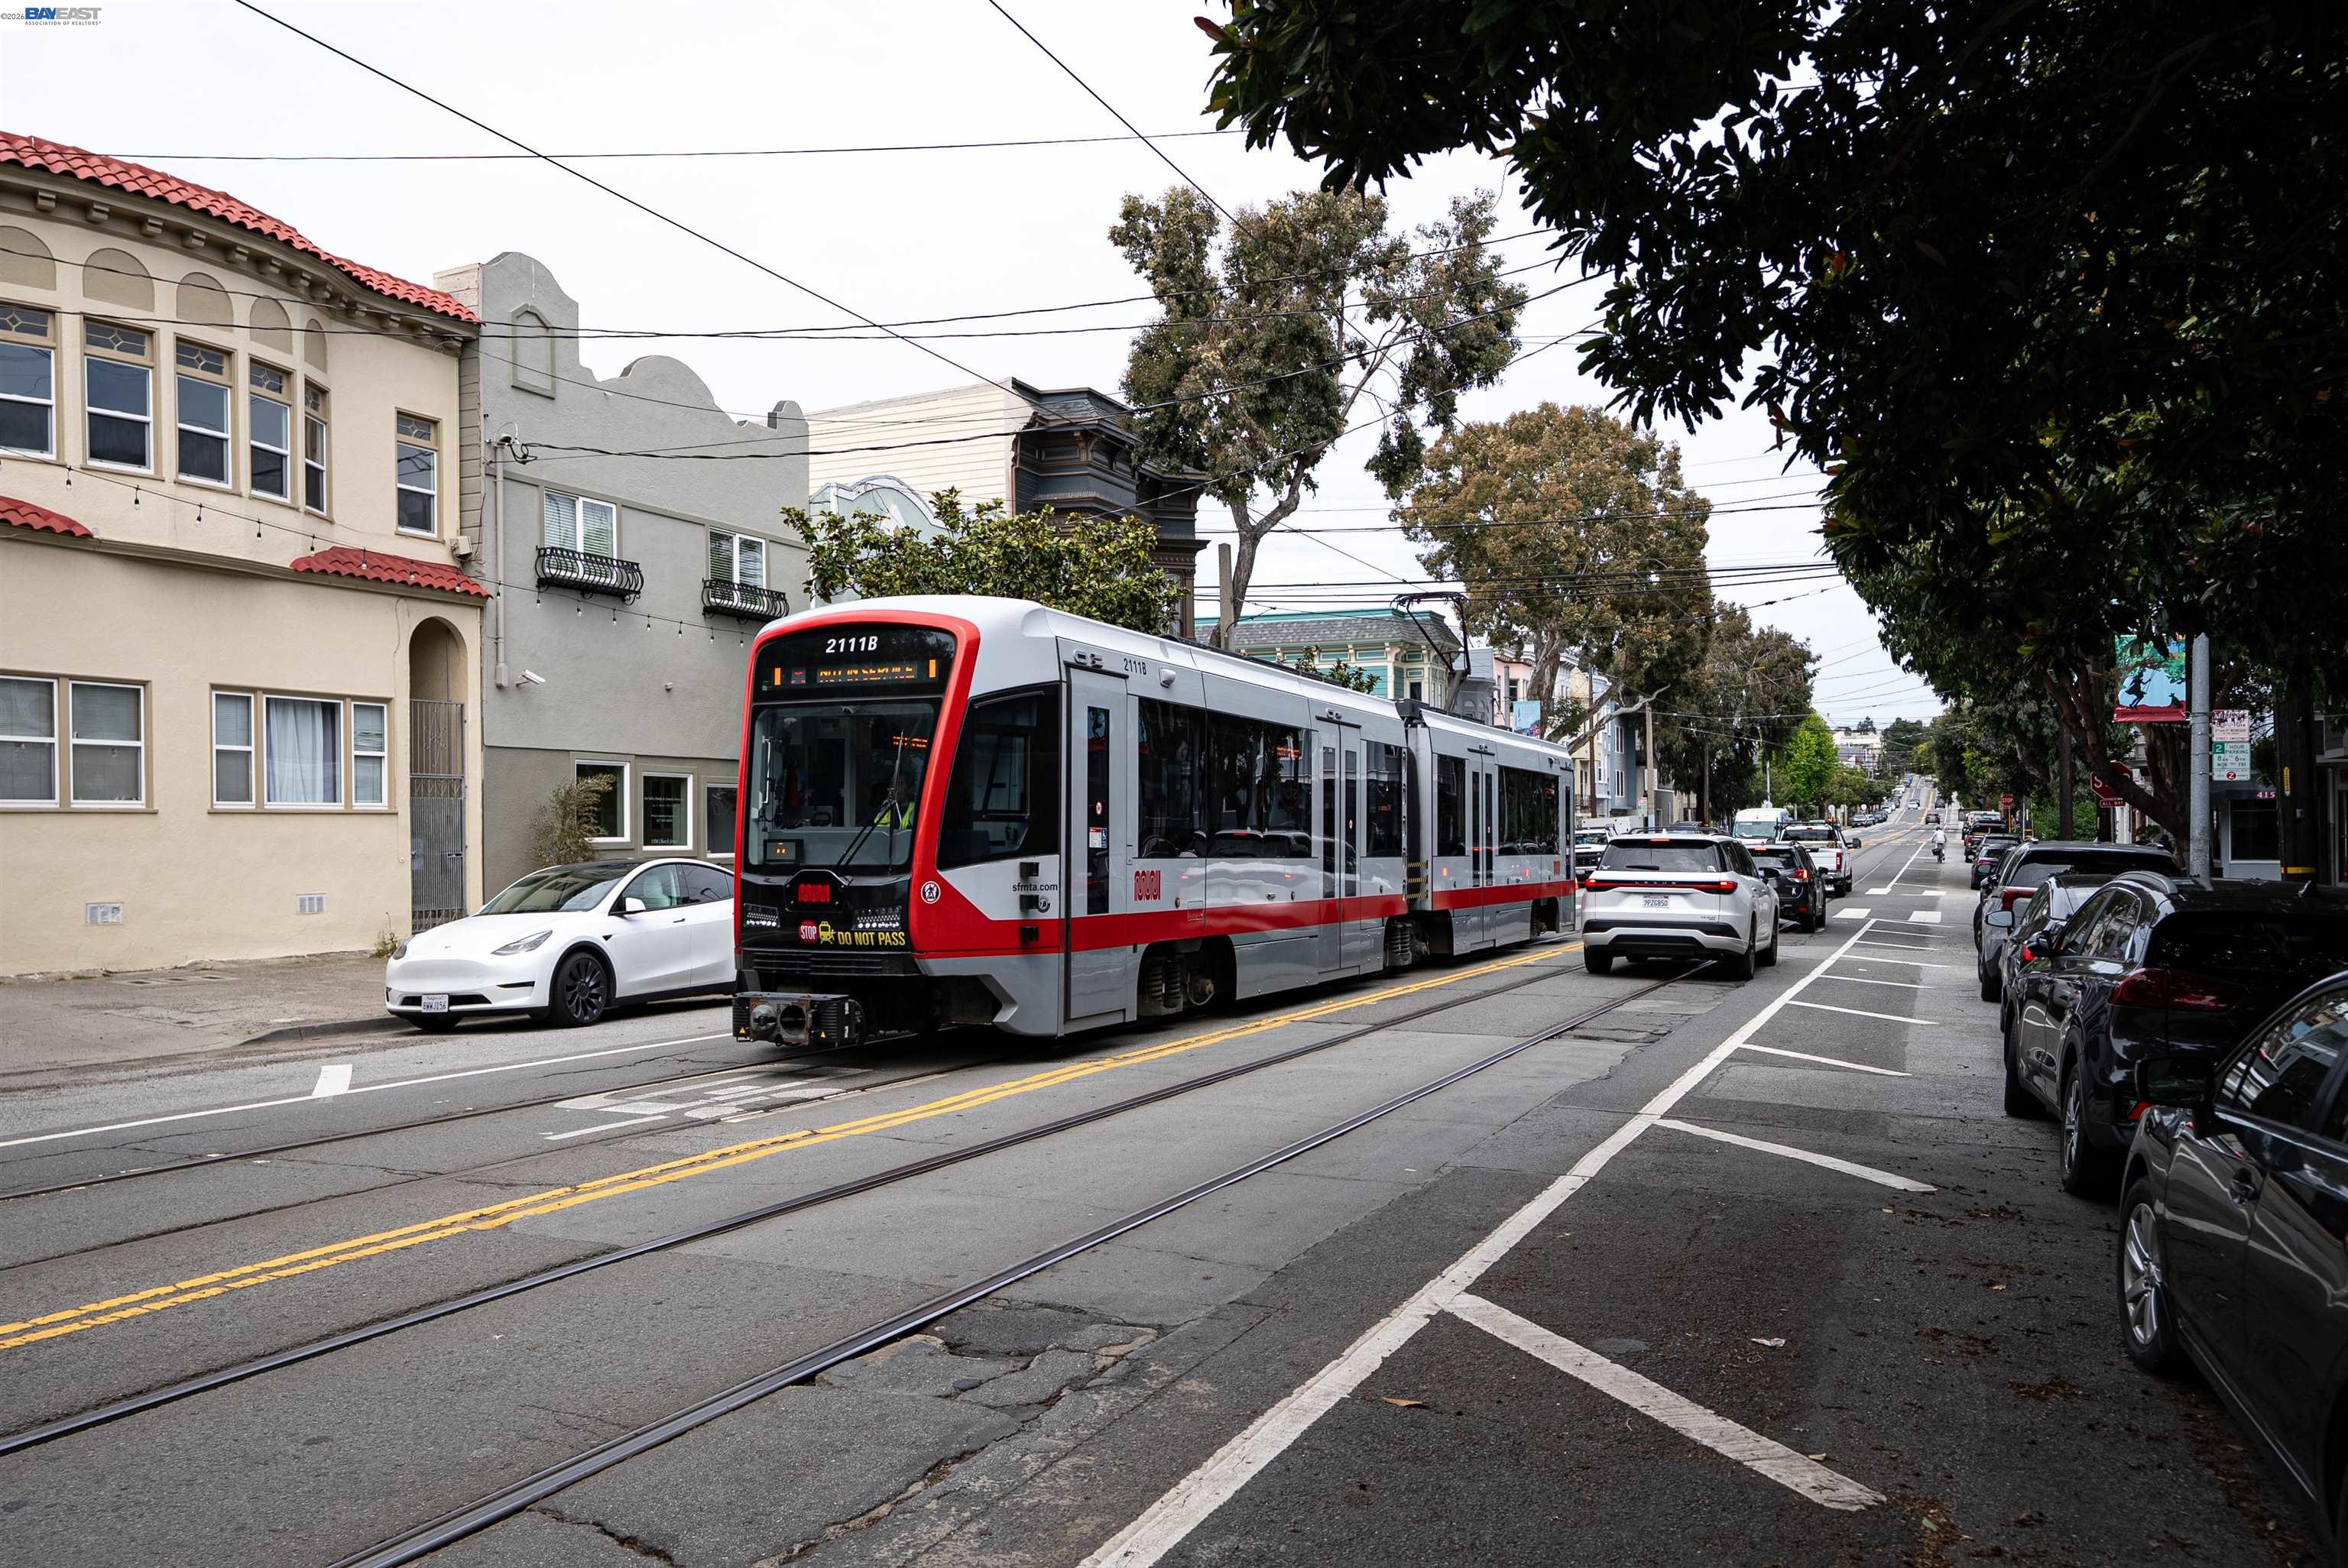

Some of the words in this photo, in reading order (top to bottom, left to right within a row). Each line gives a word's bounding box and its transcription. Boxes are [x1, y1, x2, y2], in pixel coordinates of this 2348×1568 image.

[825, 636, 878, 653] 2111B
[1124, 658, 1147, 675] 2111B
[2215, 744, 2223, 753] 2
[2257, 791, 2275, 799] 415
[1012, 882, 1058, 892] sfmta.com
[800, 925, 817, 940] STOP
[838, 931, 852, 945] DO
[855, 931, 874, 946] NOT
[878, 931, 906, 946] PASS
